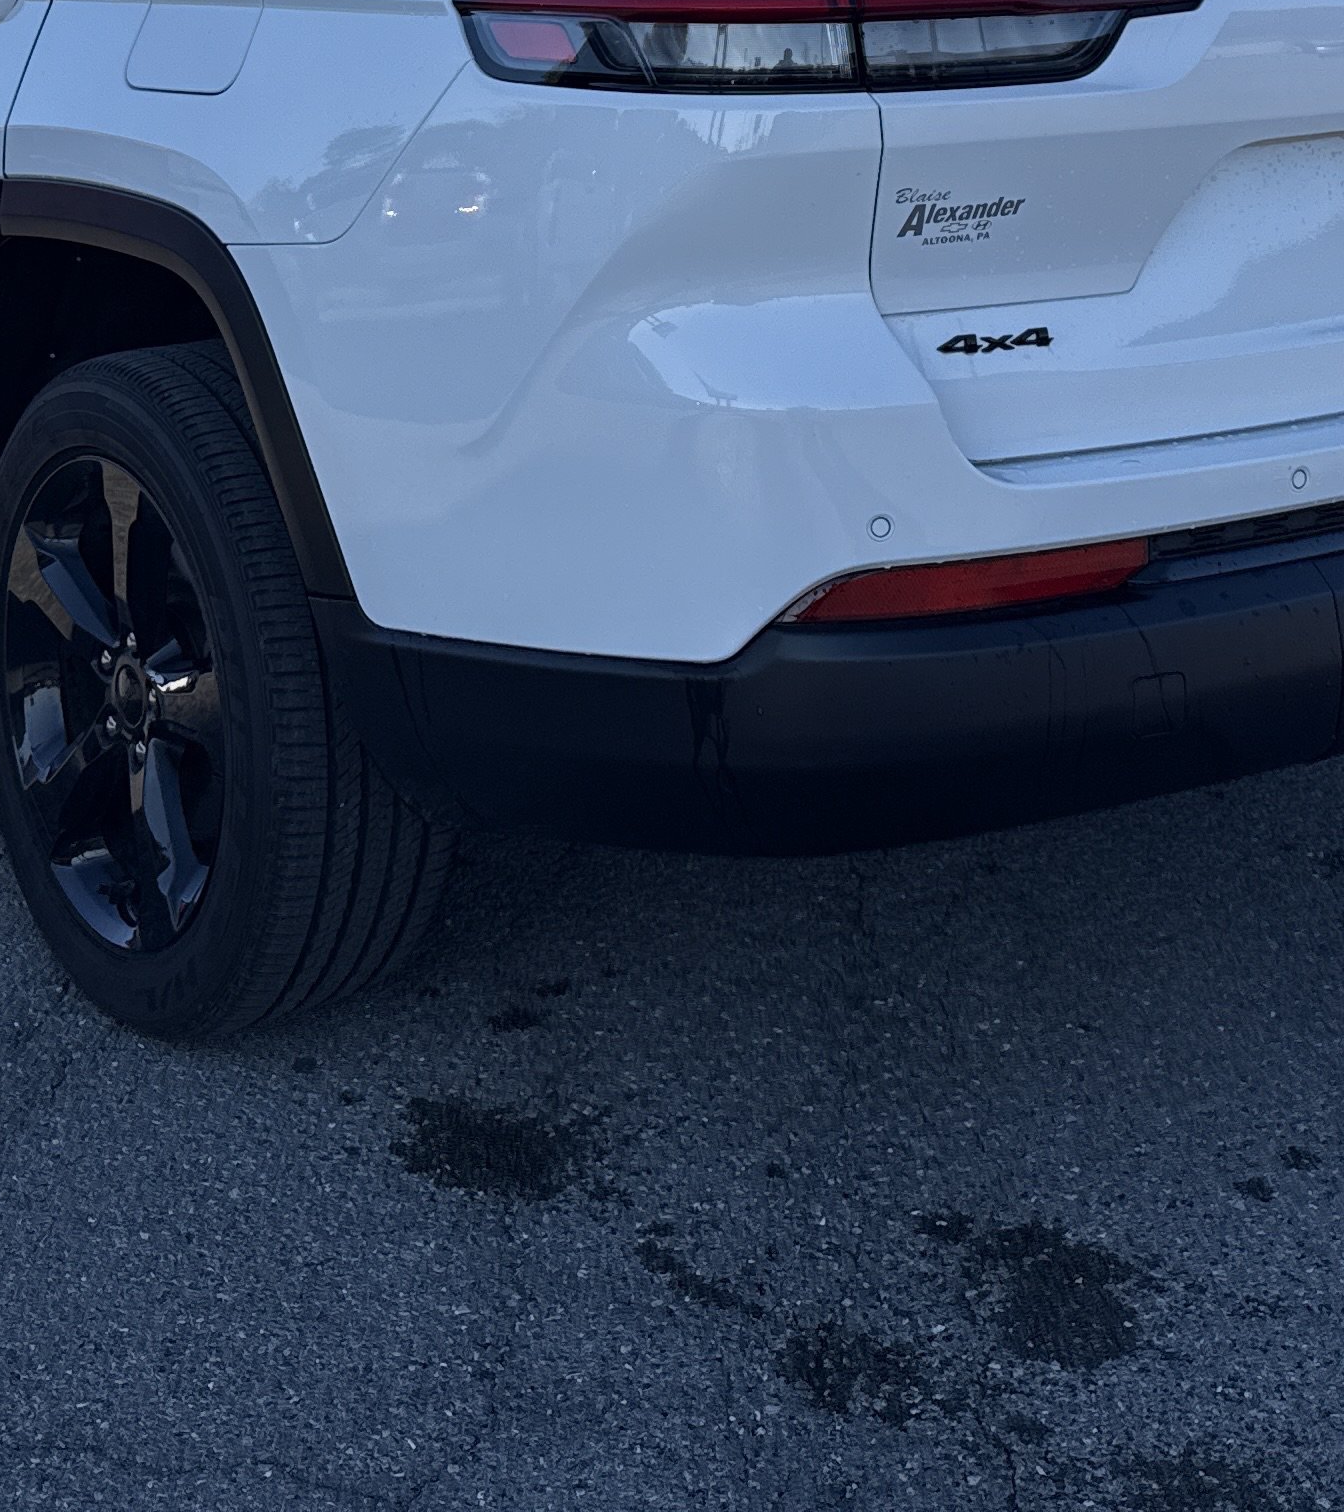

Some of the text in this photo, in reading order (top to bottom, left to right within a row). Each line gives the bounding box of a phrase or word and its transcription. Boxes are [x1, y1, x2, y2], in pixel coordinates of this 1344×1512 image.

[895, 187, 952, 204] Blaise
[896, 196, 1026, 238] Alexander
[921, 231, 991, 246] ALTOONA, PA
